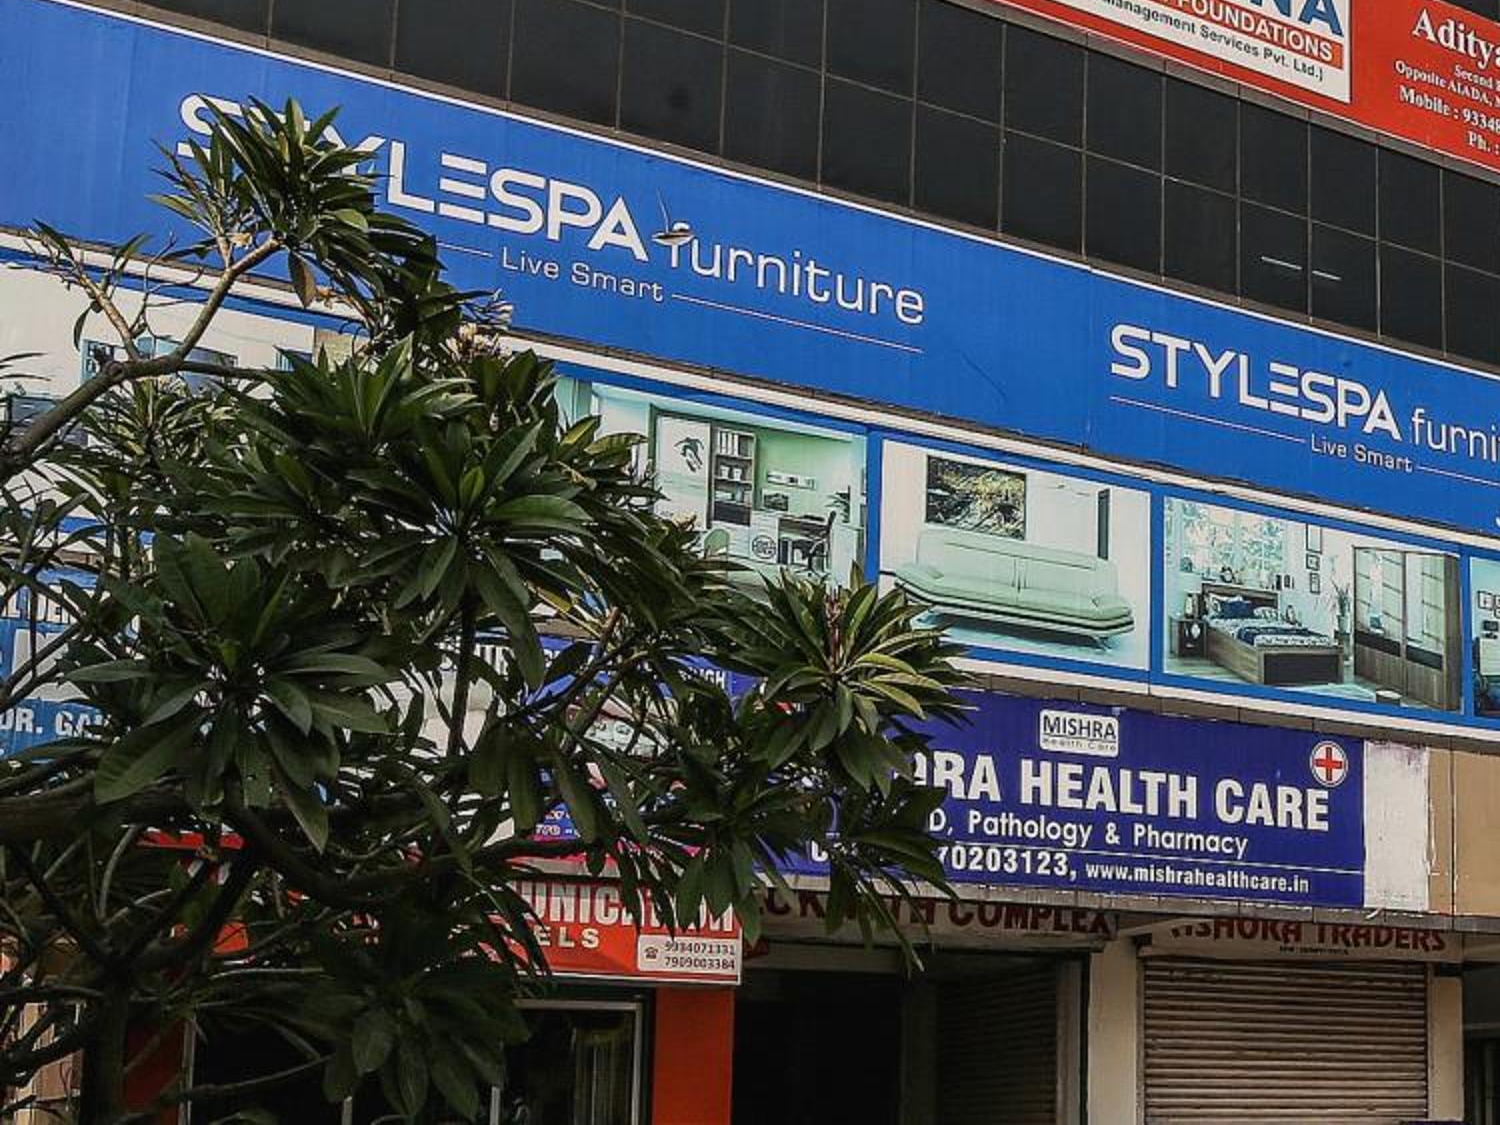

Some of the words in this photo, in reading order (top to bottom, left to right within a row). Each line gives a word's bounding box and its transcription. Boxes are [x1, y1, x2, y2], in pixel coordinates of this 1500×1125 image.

[1200, 25, 1260, 58] Services
[1263, 46, 1290, 68] Pvt.
[1293, 58, 1324, 82] Ltd.)
[1395, 60, 1447, 88] Opposite
[1454, 64, 1494, 89] Second
[1399, 85, 1450, 116] Mobile
[1468, 131, 1491, 152] Ph.
[501, 245, 560, 280] Live
[571, 262, 664, 302] Smart
[663, 222, 925, 325] furniture
[1110, 323, 1402, 443] STYLESPA
[1311, 435, 1347, 458] Live
[1354, 445, 1413, 473] Smart
[1043, 714, 1118, 741] MISHRA
[1020, 759, 1198, 820] HEALTH
[1215, 778, 1330, 832] CARE
[969, 810, 1093, 848] Pathology
[1104, 823, 1121, 845] &
[1133, 823, 1249, 858] Pharmacy
[1085, 863, 1309, 894] www.mishrahealthcare.in
[1313, 924, 1447, 952] TRADERS
